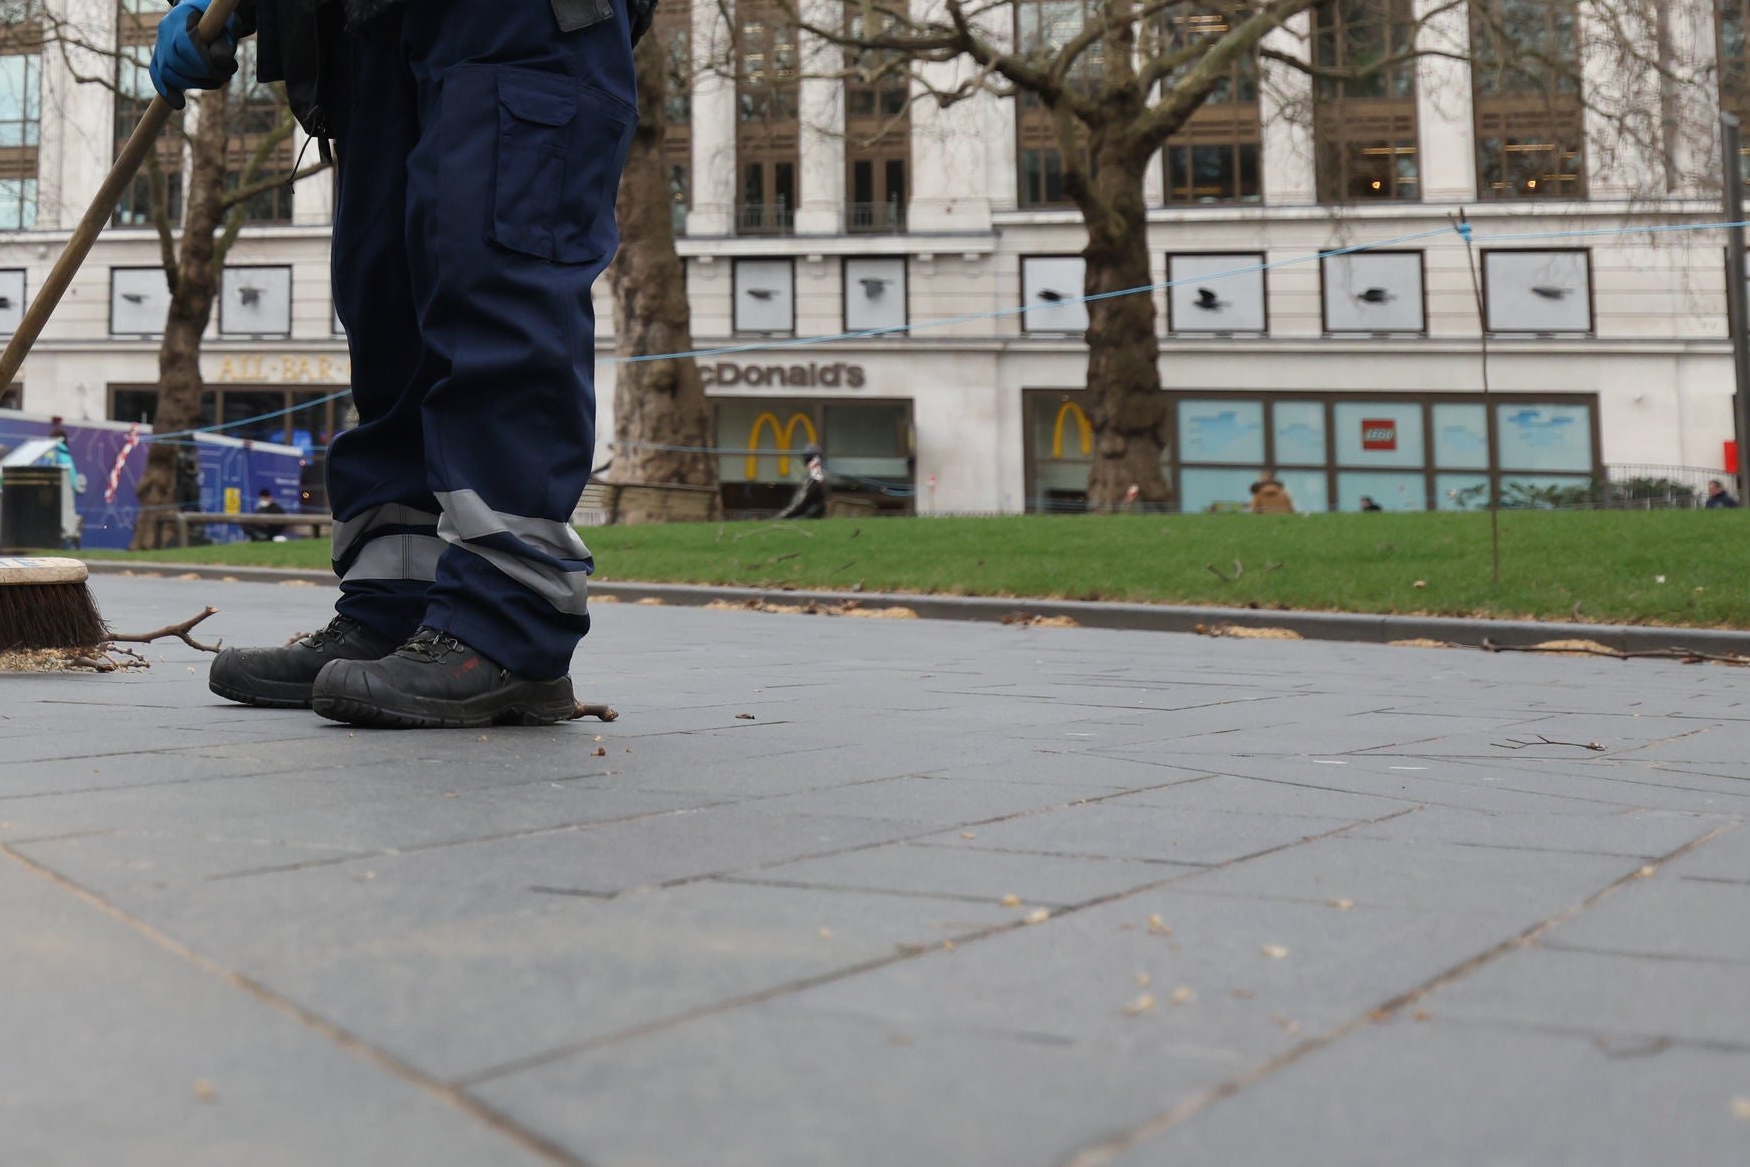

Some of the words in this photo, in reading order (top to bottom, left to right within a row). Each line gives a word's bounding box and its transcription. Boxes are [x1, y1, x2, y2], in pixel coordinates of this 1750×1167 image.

[218, 354, 268, 381] ALL
[280, 354, 337, 381] BAR
[699, 361, 865, 388] cDonald's
[1364, 427, 1395, 442] LEGO
